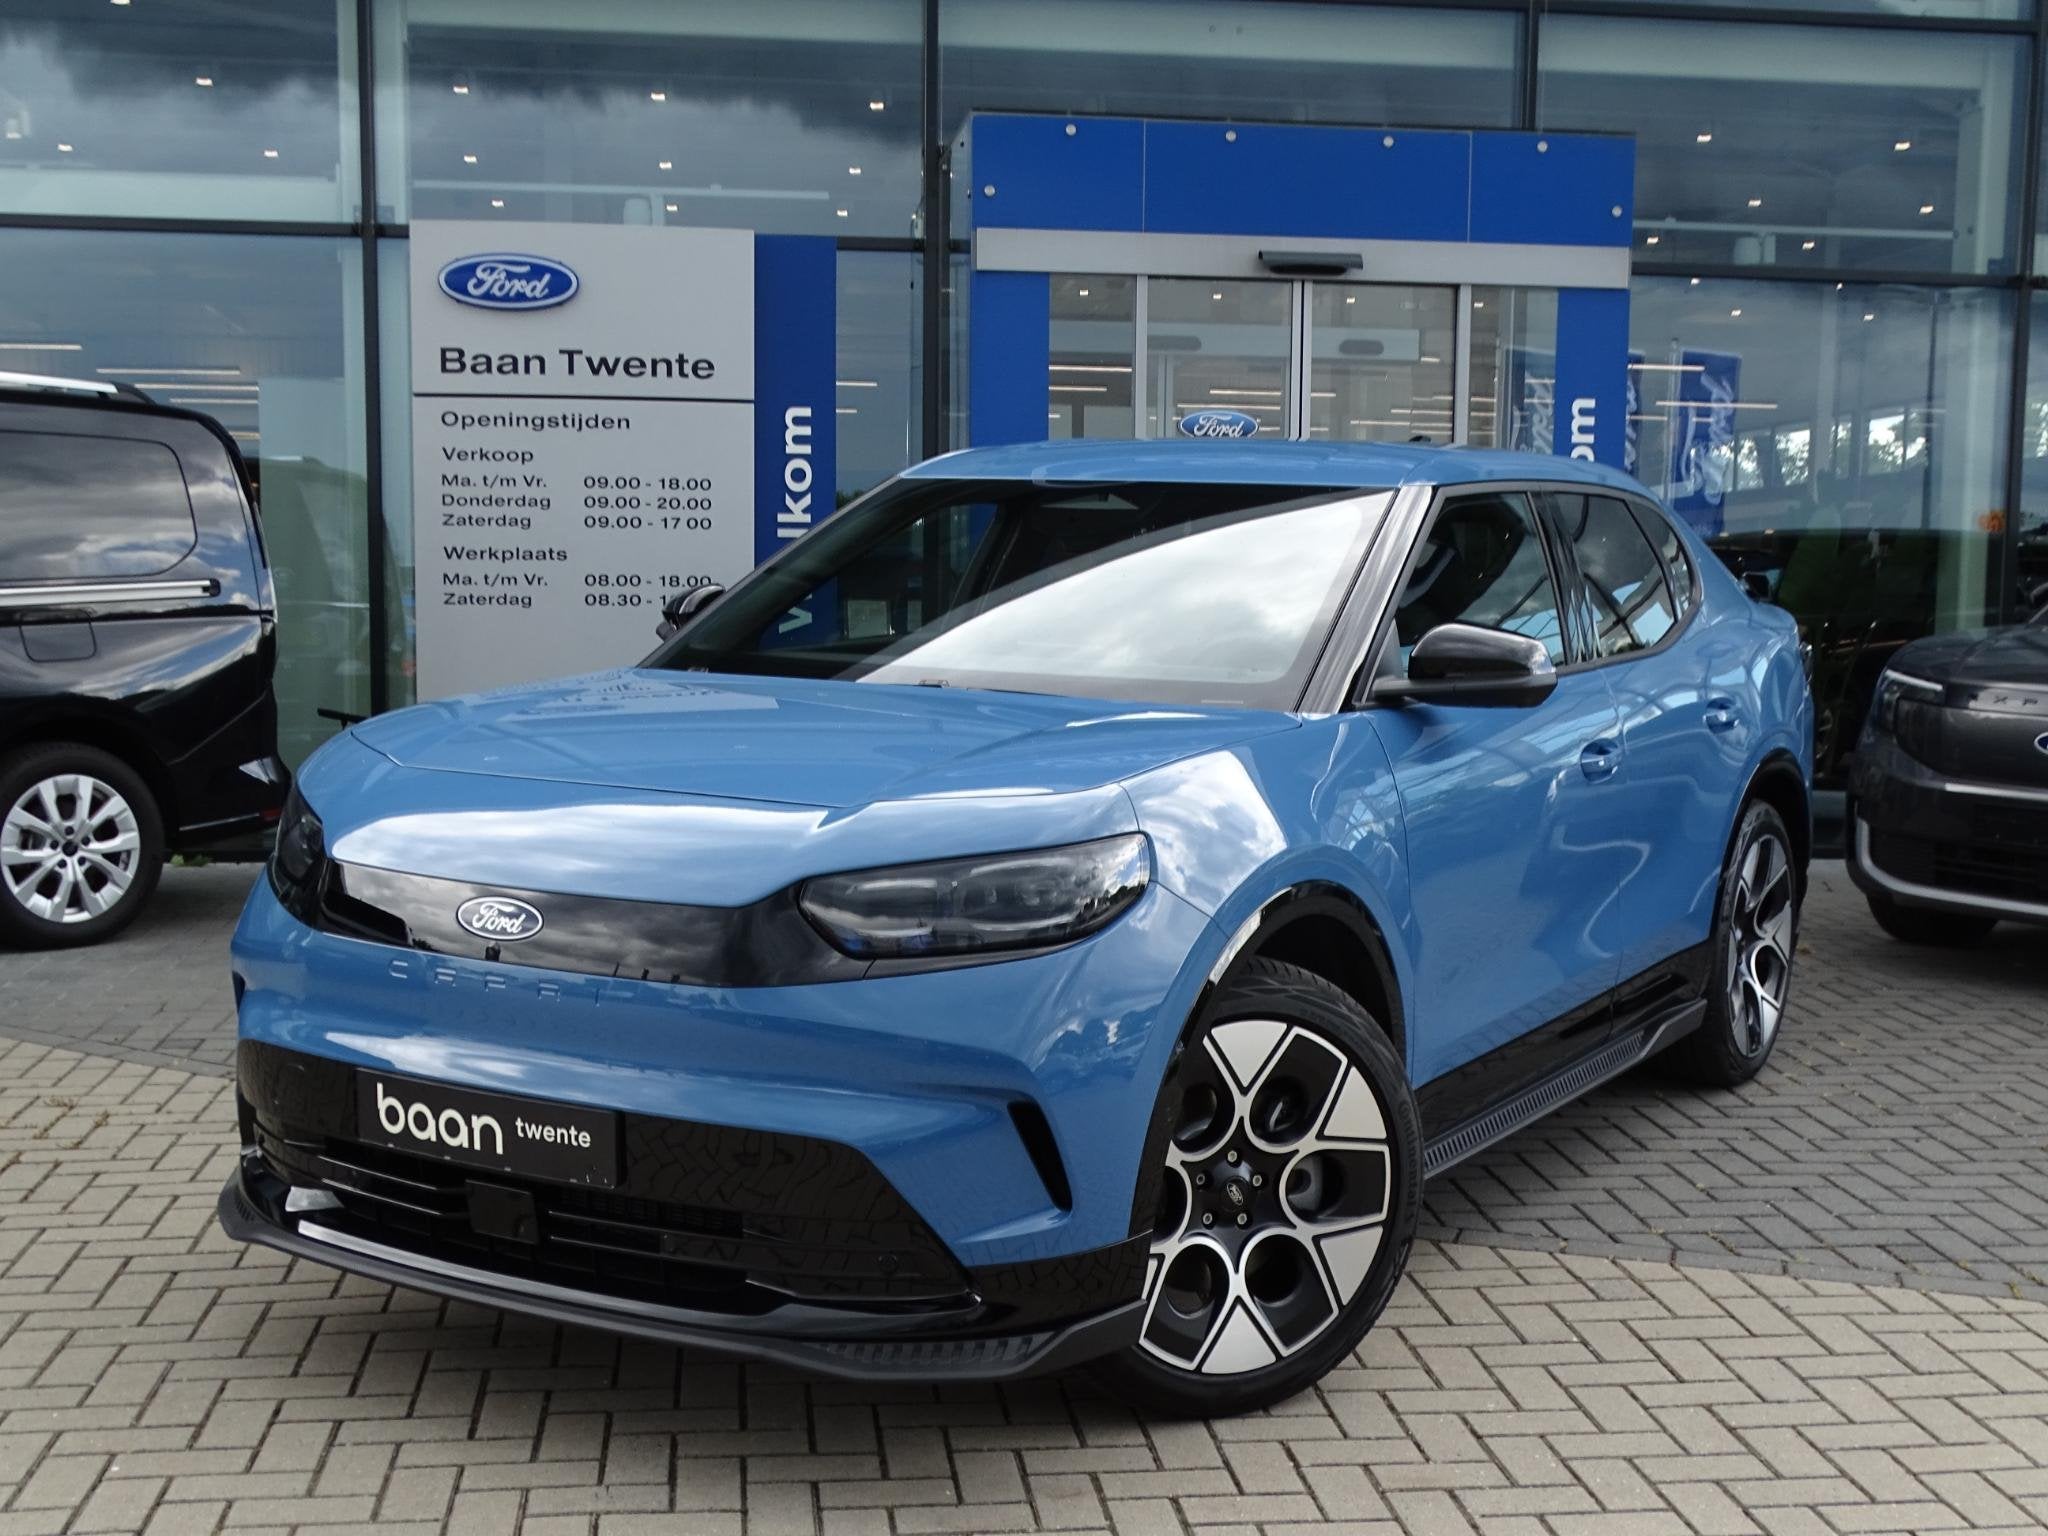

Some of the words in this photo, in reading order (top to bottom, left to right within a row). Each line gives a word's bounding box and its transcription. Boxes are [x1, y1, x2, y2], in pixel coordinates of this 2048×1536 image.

[466, 261, 551, 299] Ford
[440, 346, 546, 376] Baan
[558, 348, 716, 380] Twente
[440, 410, 631, 434] Openingstijden
[1192, 414, 1245, 438] Ford
[441, 446, 535, 466] Verkoop
[441, 473, 478, 488] Ma.
[482, 474, 518, 489] t/m
[522, 474, 547, 488] Vr.
[583, 475, 642, 490] 09.00
[658, 477, 712, 492] 18.00
[441, 493, 551, 511] Donderdag
[583, 495, 642, 510] 09.00
[656, 496, 712, 511] 20.00
[442, 513, 532, 531] Zaterdag
[583, 515, 642, 529] 09.00
[443, 545, 568, 564] Werkplaats
[442, 572, 479, 587] Ma.
[483, 573, 518, 588] t/m
[523, 573, 548, 587] Vr.
[584, 573, 642, 588] 08.00
[443, 592, 532, 609] Zaterdag
[584, 593, 642, 607] 08.30
[472, 901, 527, 934] Ford
[376, 1081, 504, 1155] baan
[515, 1116, 592, 1148] twente
